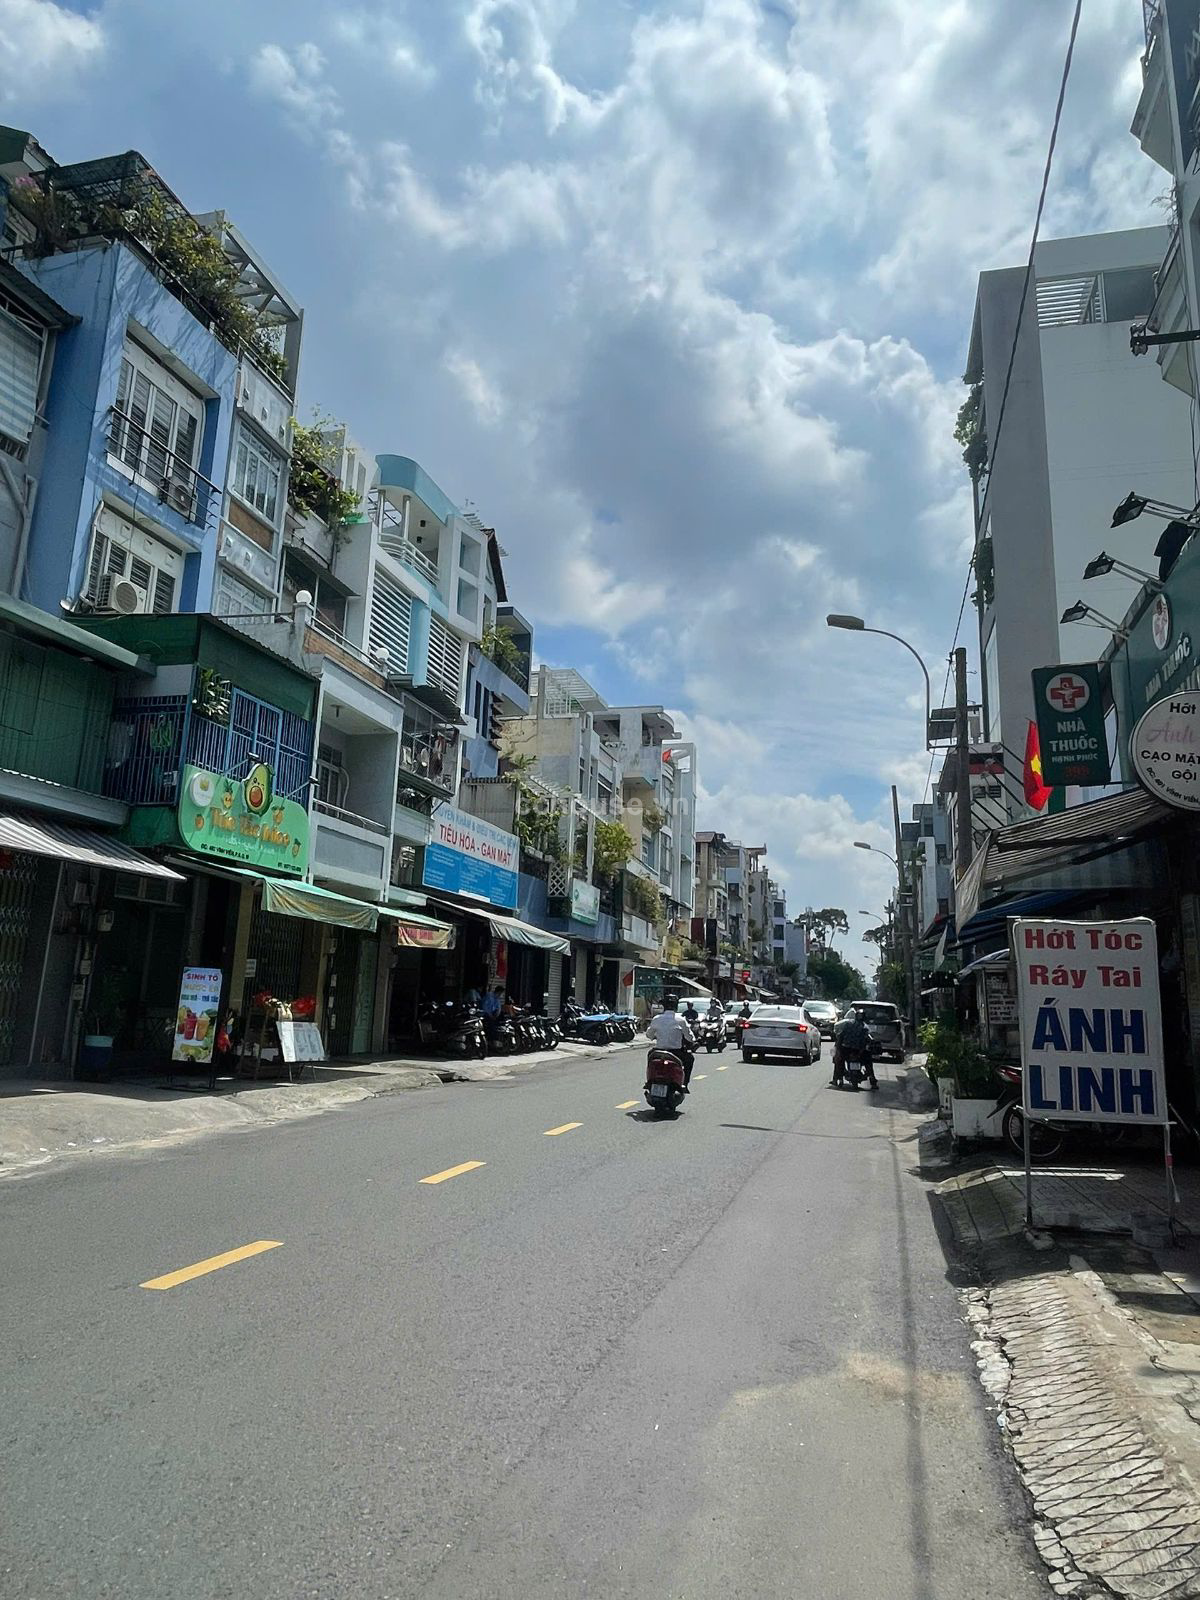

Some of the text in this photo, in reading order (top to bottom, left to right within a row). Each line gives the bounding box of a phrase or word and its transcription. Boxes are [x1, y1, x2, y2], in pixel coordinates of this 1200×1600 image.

[1162, 631, 1190, 682] THUỐC
[1169, 702, 1196, 715] Hớt
[1056, 717, 1086, 733] NHÀ
[1049, 734, 1098, 752] THUỐC
[1141, 750, 1171, 763] CẠO
[1171, 769, 1197, 783] GỘI
[481, 842, 496, 861] GAN
[1024, 928, 1143, 950] Hớt Tóc
[186, 973, 206, 981] SINH
[1029, 964, 1087, 988] Ráy
[1097, 966, 1141, 987] Tai
[1031, 997, 1147, 1054] ÁNH
[1029, 1065, 1155, 1115] LINH
